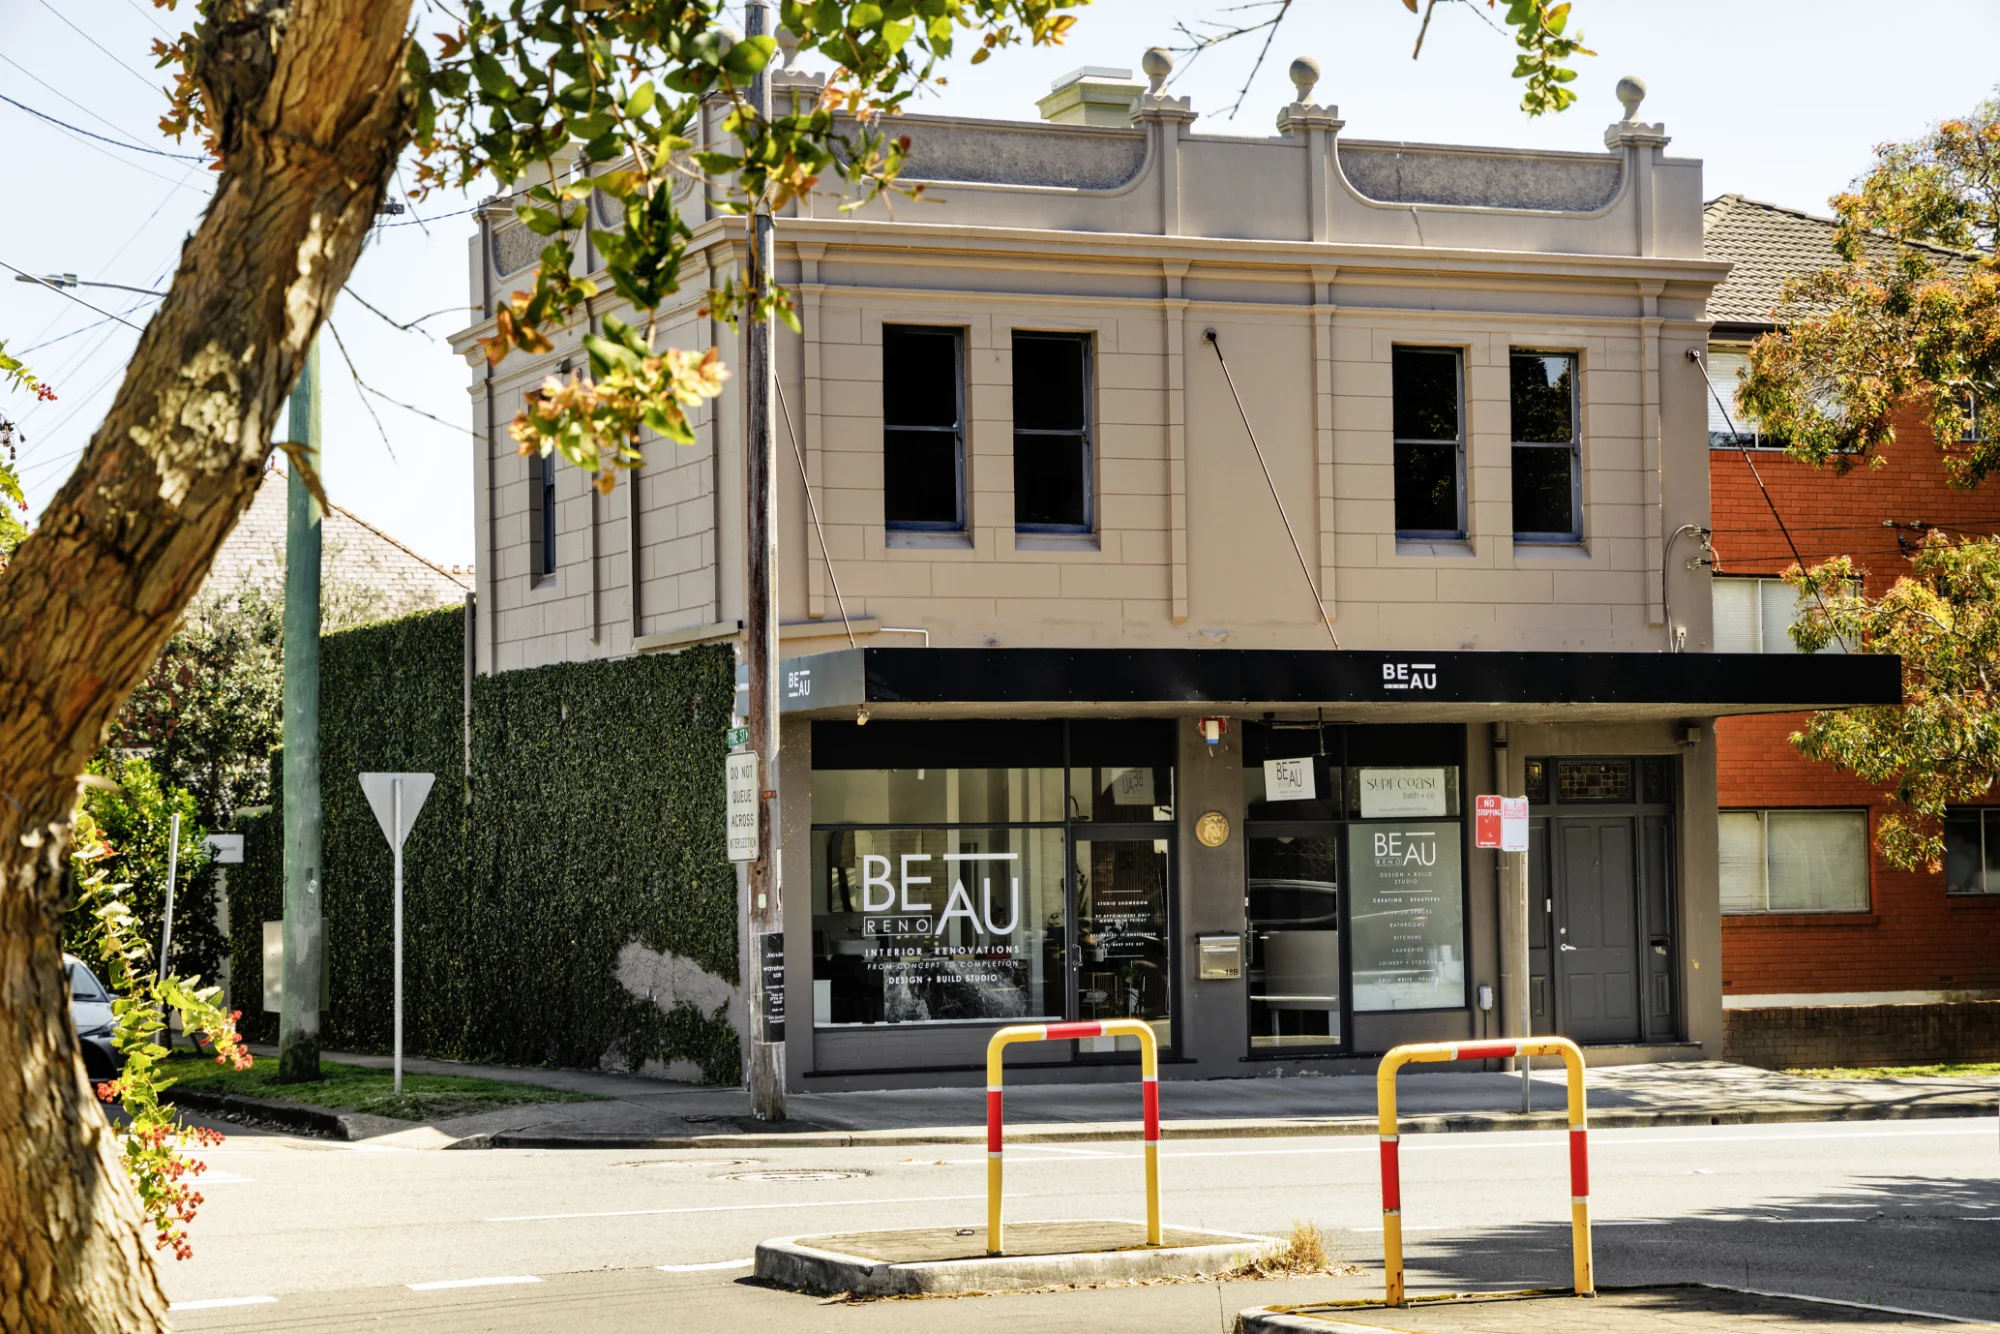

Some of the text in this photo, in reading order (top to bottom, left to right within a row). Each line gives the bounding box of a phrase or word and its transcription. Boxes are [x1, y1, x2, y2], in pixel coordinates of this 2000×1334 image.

[730, 765, 753, 780] DO NOT
[732, 789, 752, 804] QUEUE
[1402, 791, 1419, 800] bath
[1483, 799, 1495, 808] NO
[1476, 808, 1502, 817] STOPPING
[1504, 810, 1527, 818] ZONE
[731, 813, 754, 828] ACROSS
[867, 919, 929, 933] RENO
[865, 945, 1020, 957] INTERIOR RENOVATIONS
[867, 960, 1019, 971] FROM CONCEPT TO COMPLETION
[1225, 968, 1239, 976] 18B
[888, 976, 923, 985] DESIGN
[936, 975, 962, 984] BUILD
[965, 974, 998, 983] STUDIO
